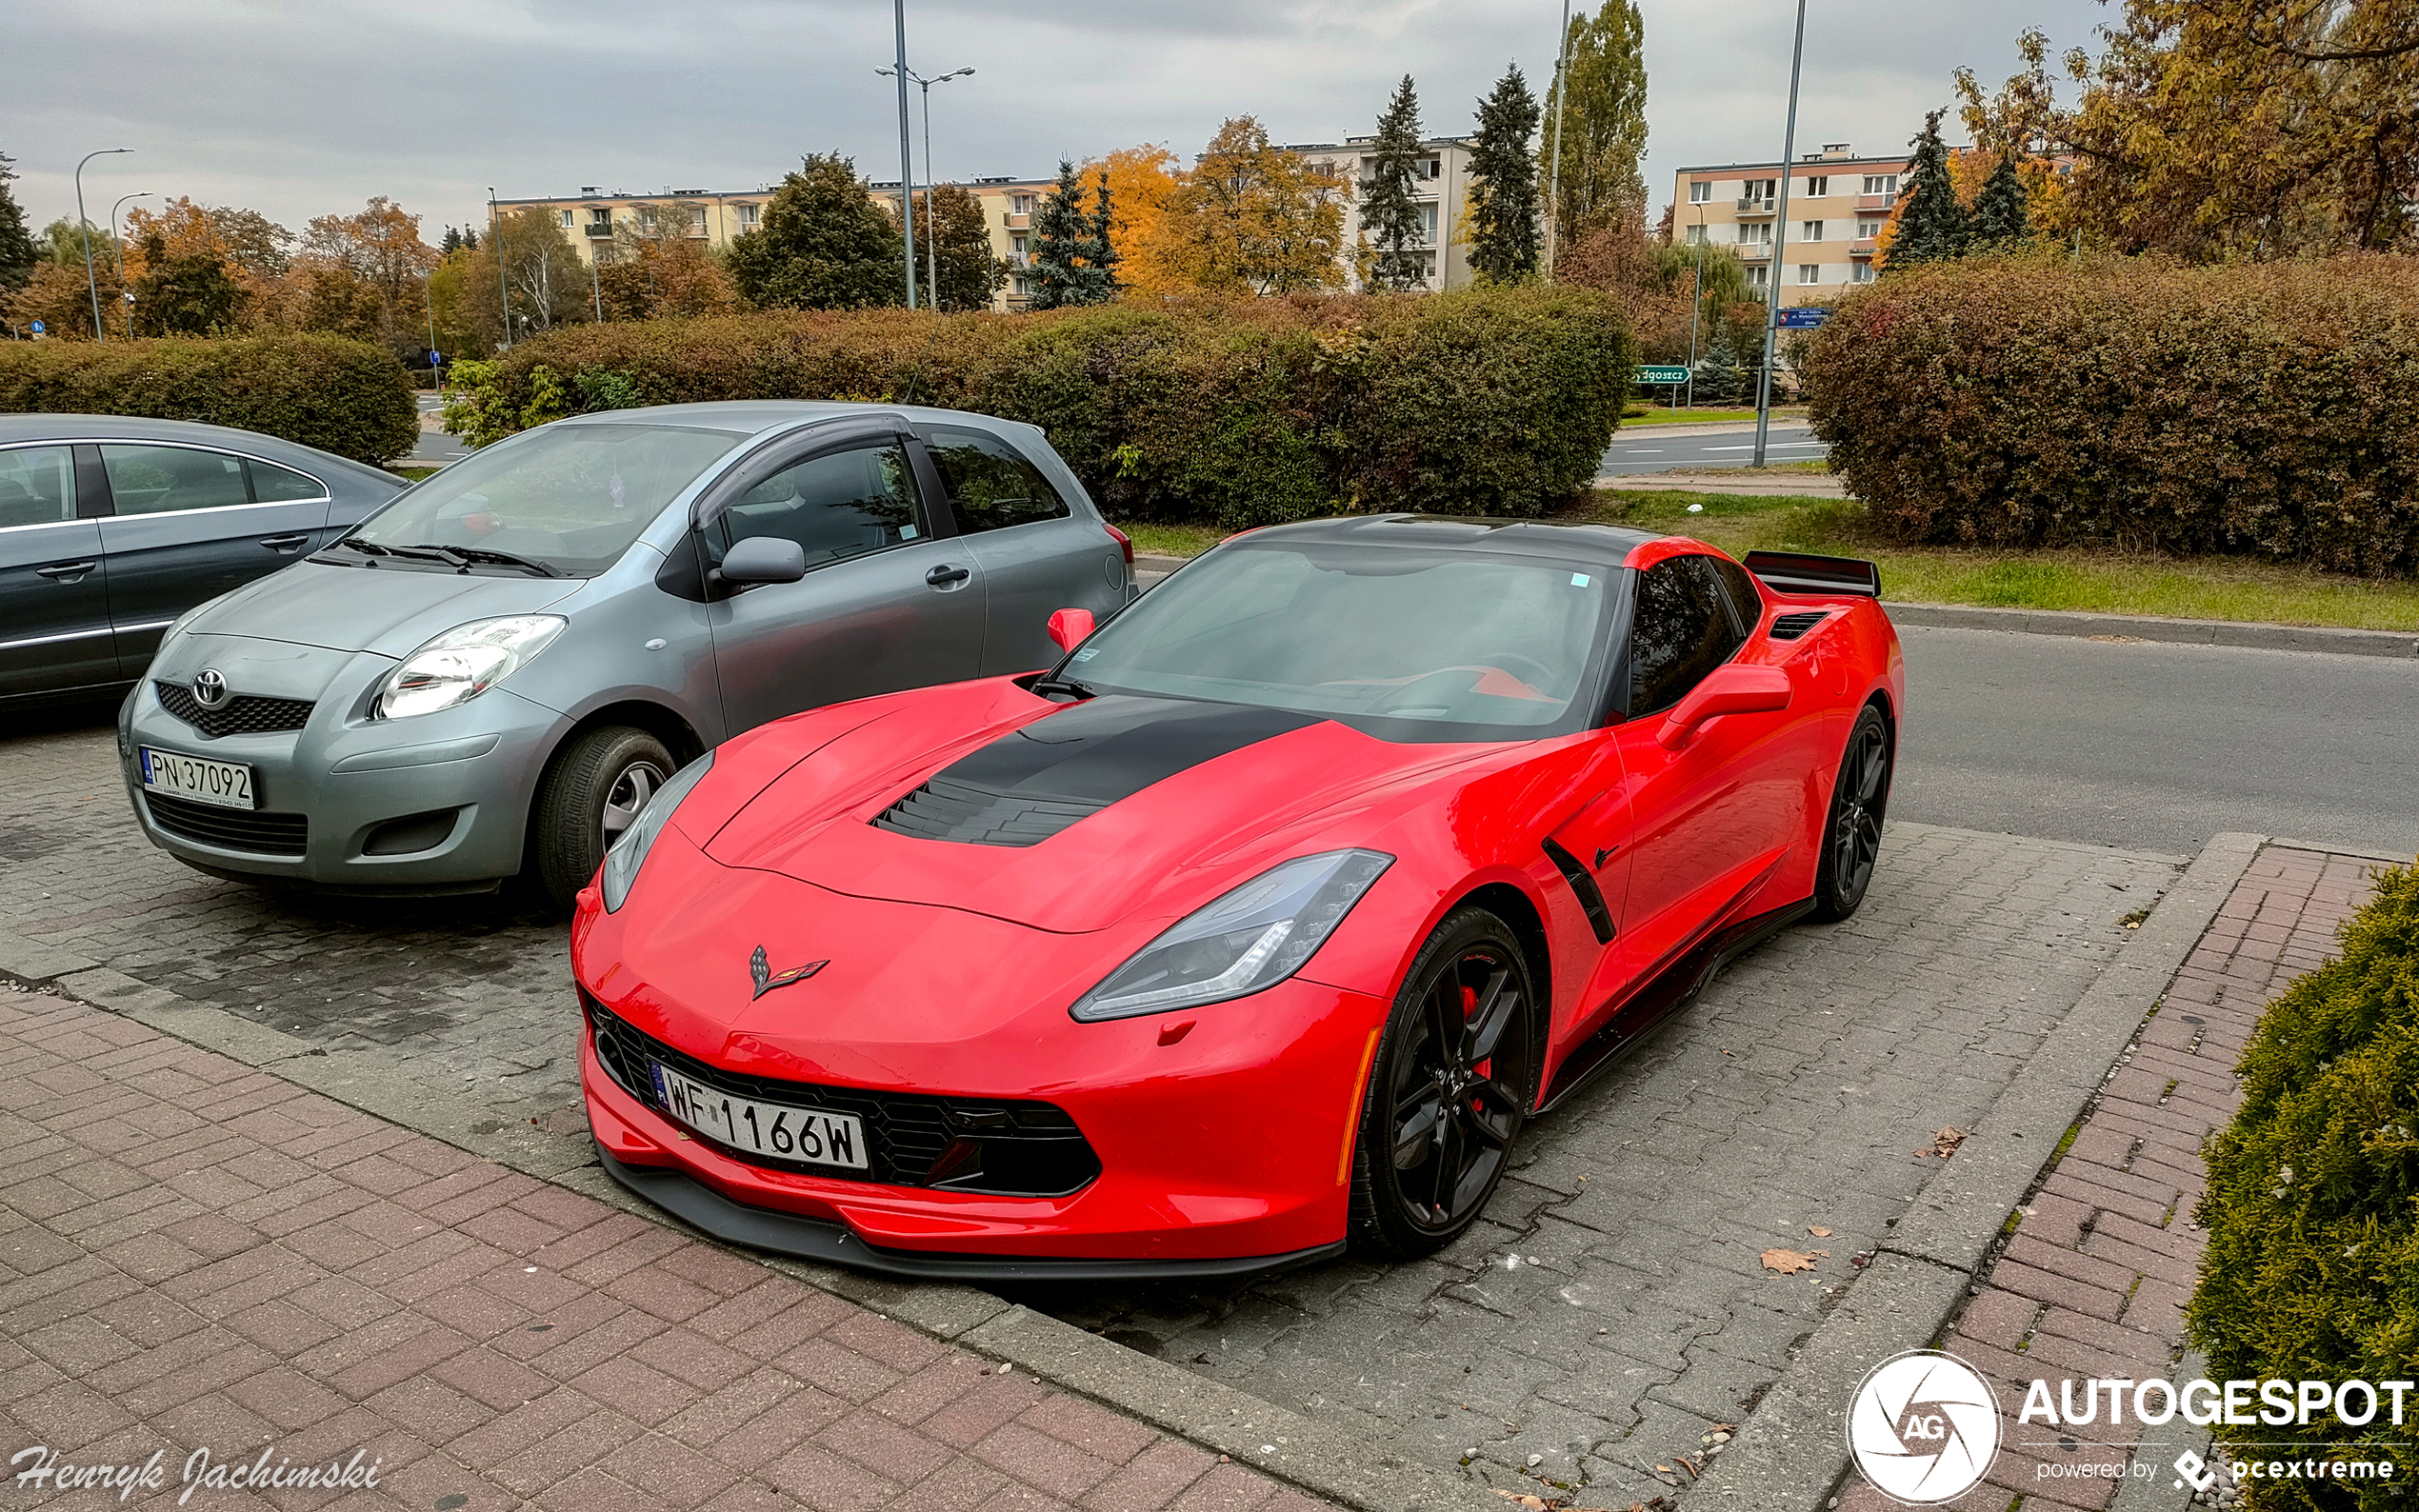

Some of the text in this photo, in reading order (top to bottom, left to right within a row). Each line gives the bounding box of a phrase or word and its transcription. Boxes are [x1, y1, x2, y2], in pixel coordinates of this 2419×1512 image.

[146, 770, 152, 779] PL
[151, 753, 250, 800] PN 37092
[657, 1089, 669, 1105] PL
[667, 1072, 854, 1164] WF 1166W
